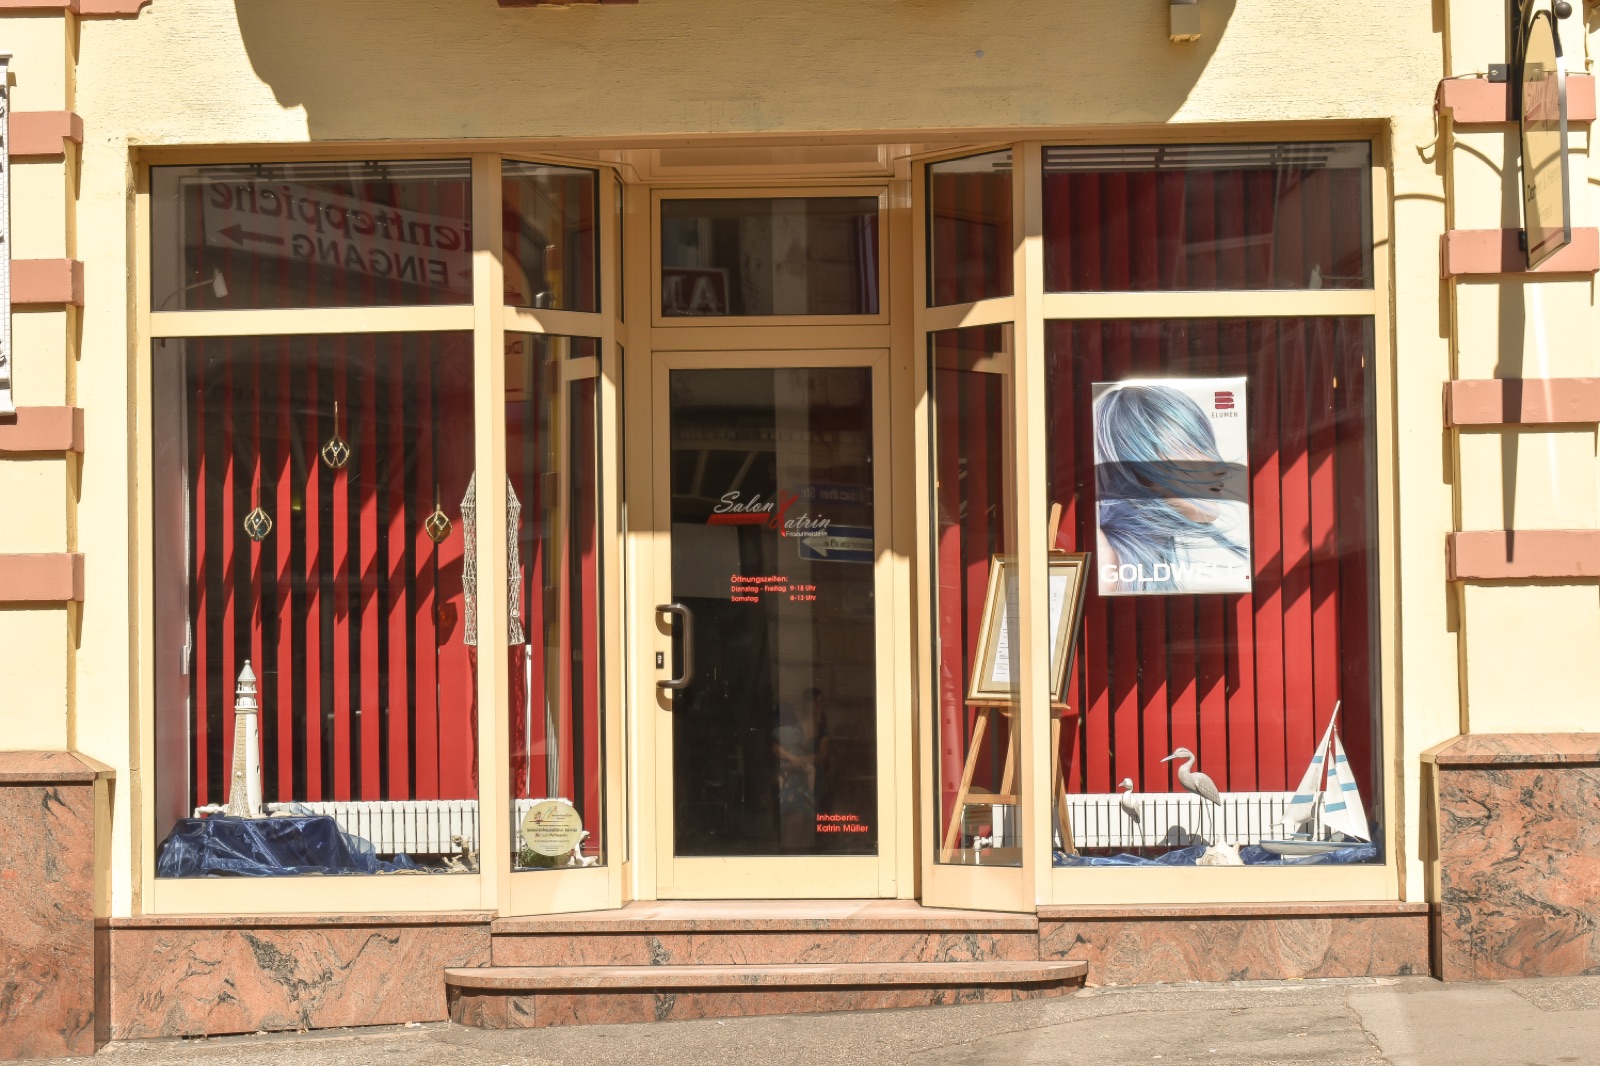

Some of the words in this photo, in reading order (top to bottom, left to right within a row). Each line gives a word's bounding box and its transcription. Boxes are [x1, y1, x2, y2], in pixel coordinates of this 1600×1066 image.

[713, 490, 774, 513] Salon
[731, 574, 788, 583] Öffnungszeiten:
[816, 813, 859, 821] Inhaberin:
[816, 824, 841, 832] Katrin
[843, 823, 869, 832] Müller
